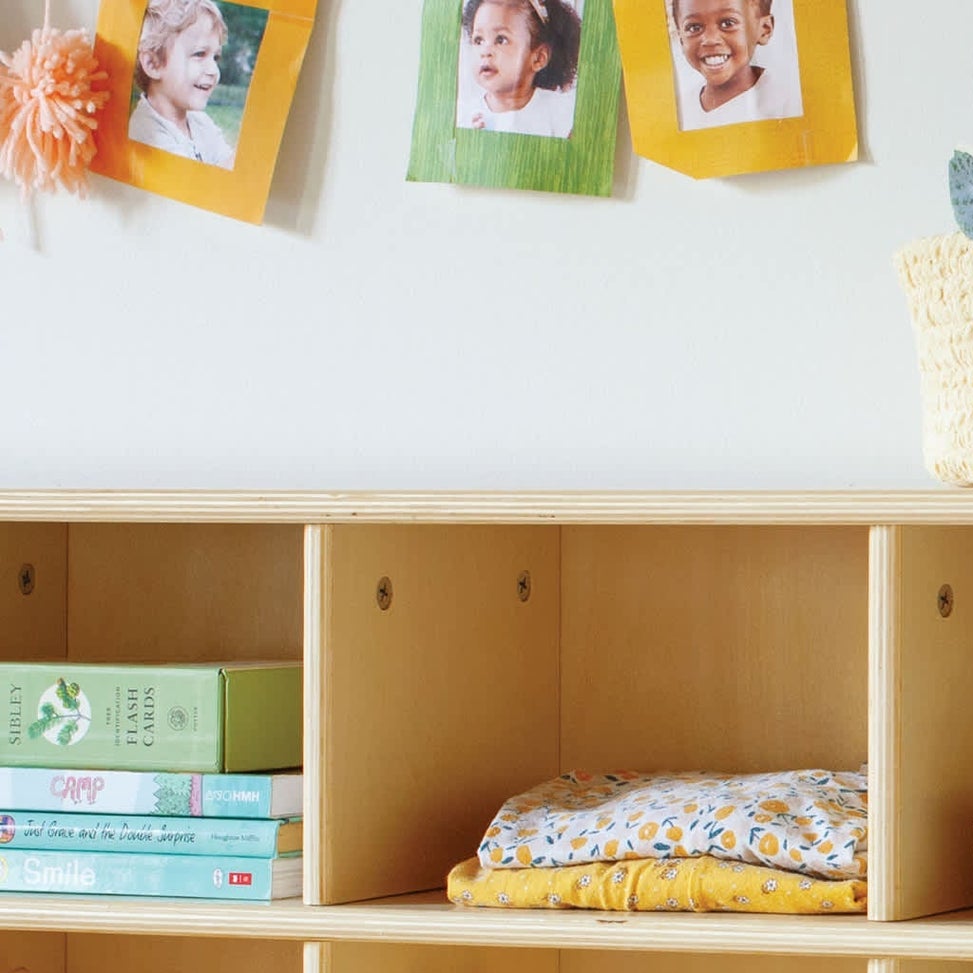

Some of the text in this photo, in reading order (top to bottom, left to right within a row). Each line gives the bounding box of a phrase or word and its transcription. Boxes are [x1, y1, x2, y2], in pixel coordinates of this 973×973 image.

[9, 684, 21, 745] SIBLEY
[127, 688, 138, 745] FLASH
[143, 687, 154, 747] CARDS
[50, 775, 105, 804] CAMP
[233, 791, 260, 802] HMH
[24, 820, 195, 846] Just Grace and the Double Surprise
[24, 857, 96, 886] Smile
